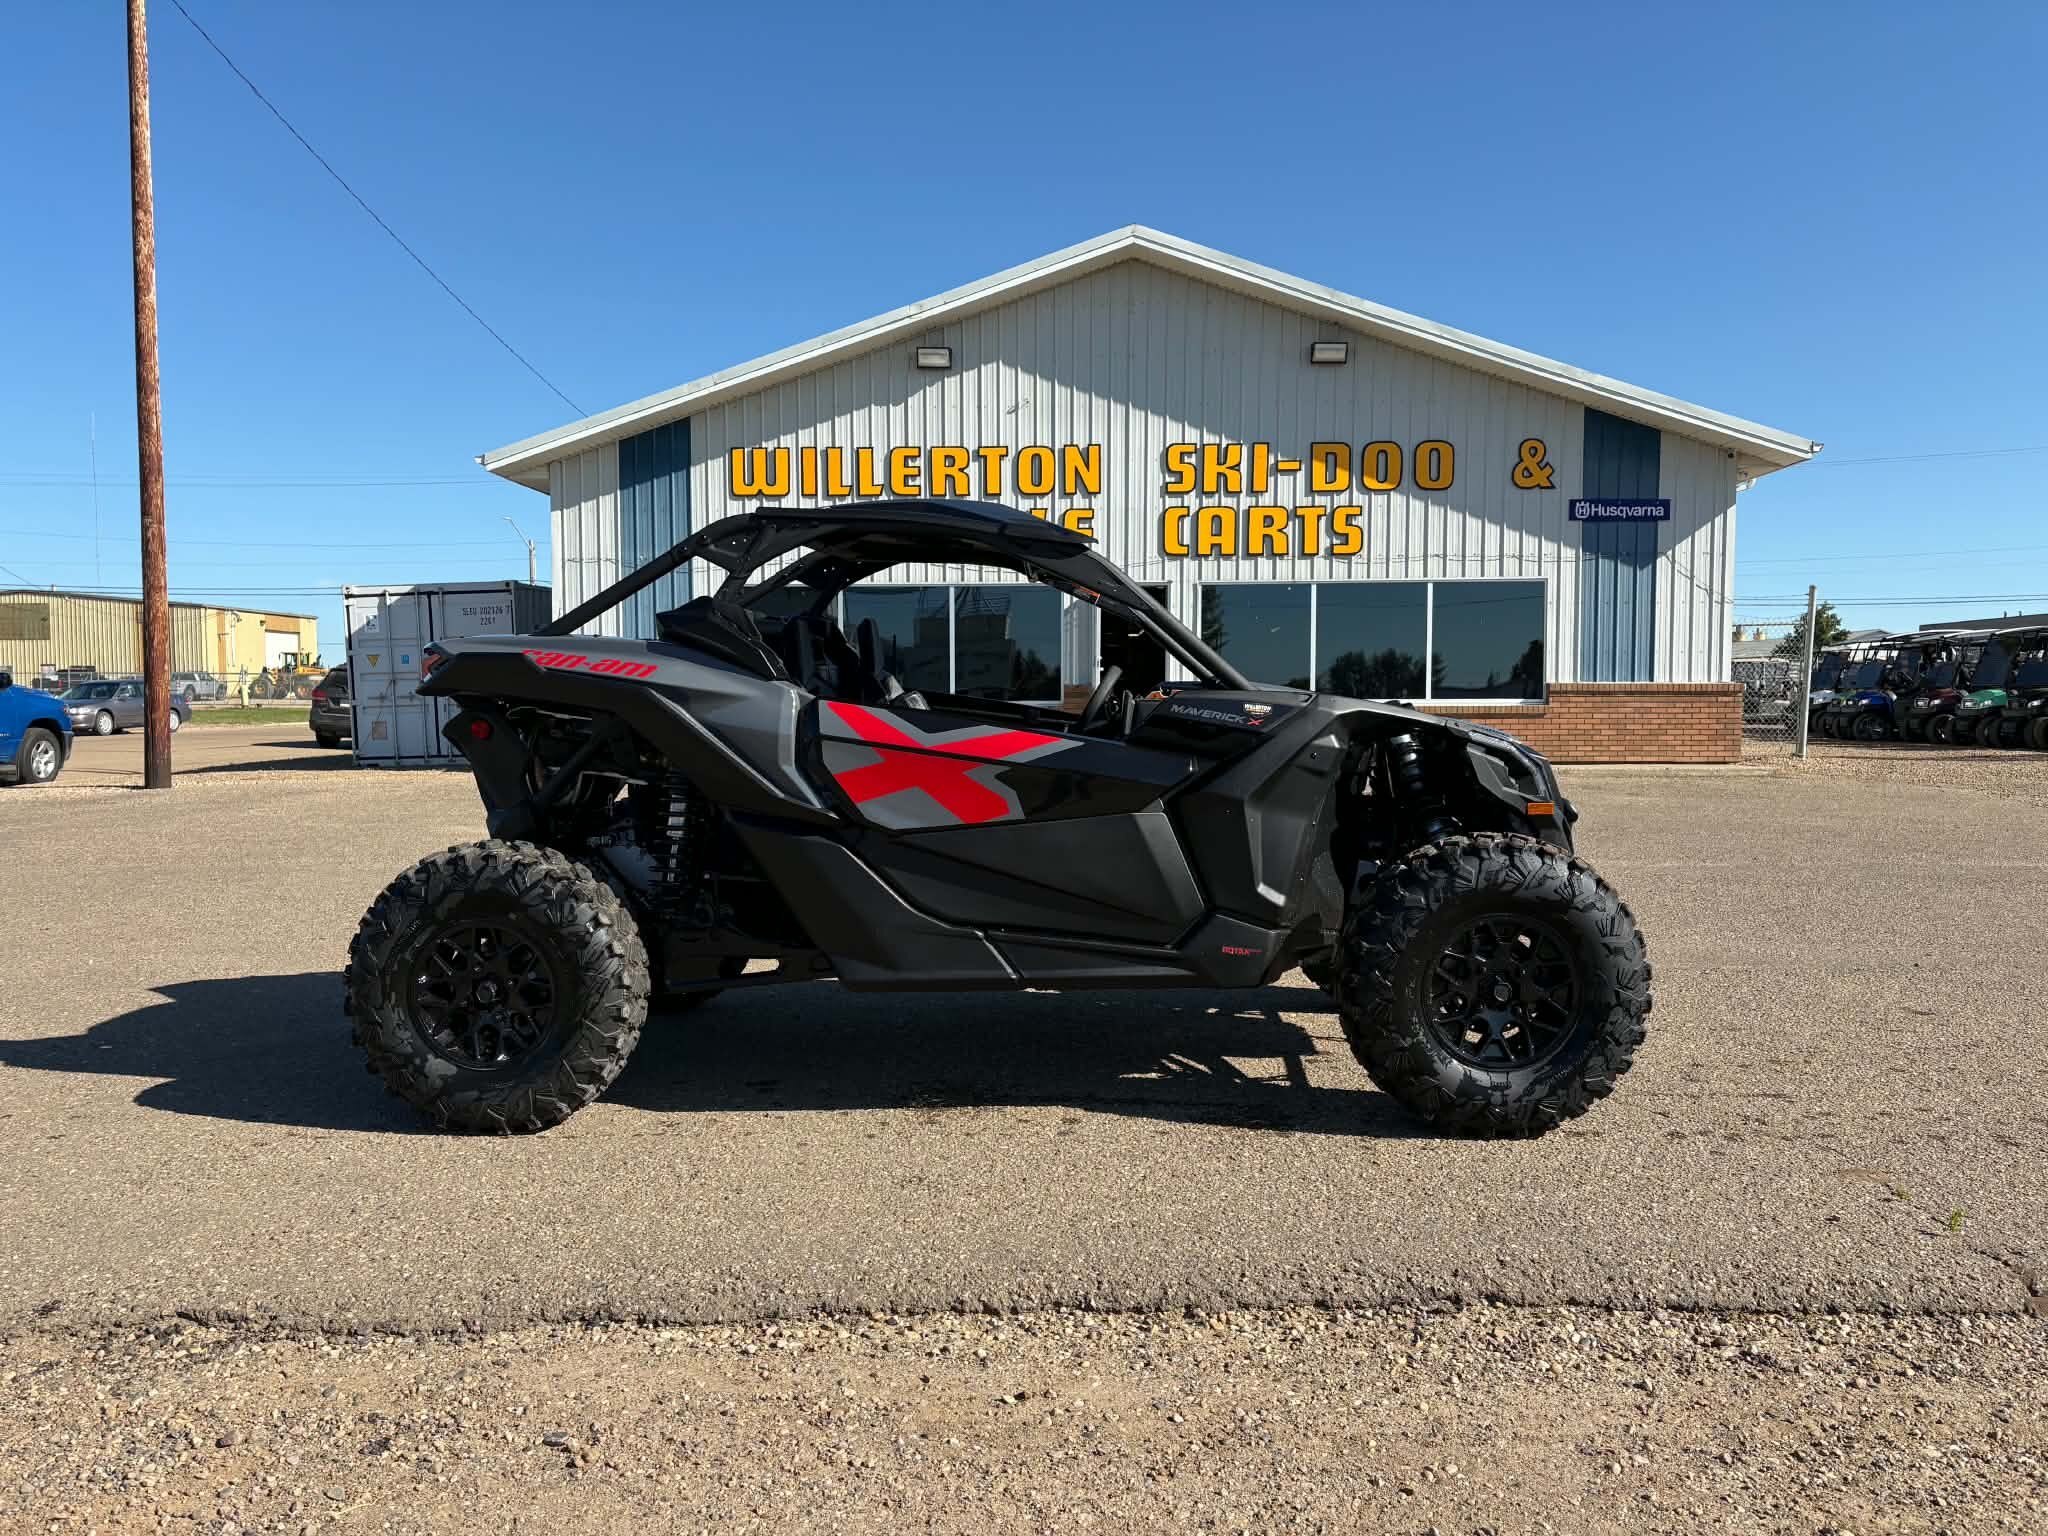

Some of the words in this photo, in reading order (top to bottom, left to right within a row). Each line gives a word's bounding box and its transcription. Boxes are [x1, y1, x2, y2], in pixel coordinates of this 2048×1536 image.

[729, 443, 1102, 497] WILLERTON
[1165, 440, 1456, 494] SKI-DOO
[1511, 438, 1556, 490] &
[1162, 505, 1365, 557] CARTS
[1590, 503, 1665, 519] Husqvarna
[522, 649, 659, 678] can-am
[1170, 704, 1247, 724] MAVERICK
